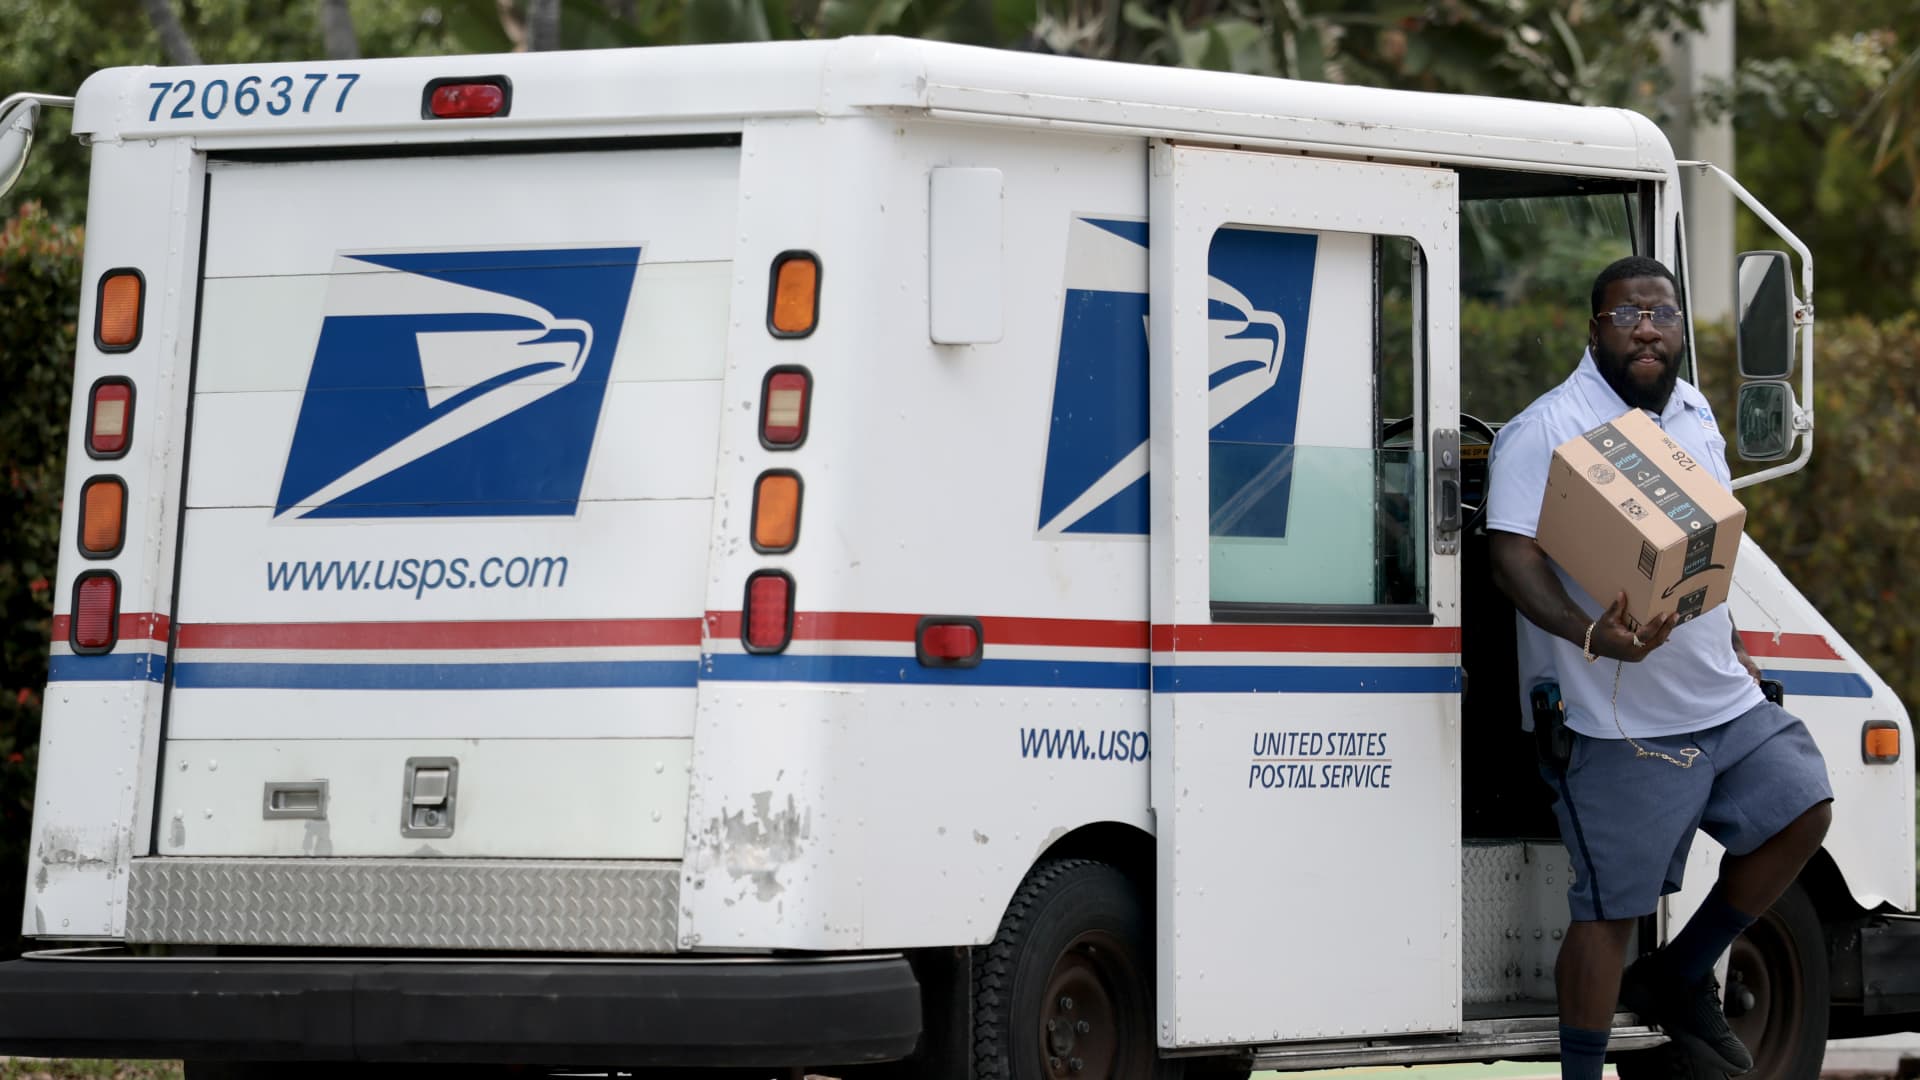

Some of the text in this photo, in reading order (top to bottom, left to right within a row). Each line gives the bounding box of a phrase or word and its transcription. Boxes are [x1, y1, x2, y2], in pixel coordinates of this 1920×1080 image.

[148, 73, 361, 122] 7206377
[1615, 452, 1638, 470] prime
[1671, 450, 1697, 472] 128
[1667, 502, 1691, 518] prime
[266, 556, 569, 600] www.usps.com
[1020, 727, 1151, 765] www.usp
[1253, 732, 1387, 756] UNITED STATES
[1248, 764, 1392, 789] POSTAL SERVICE
